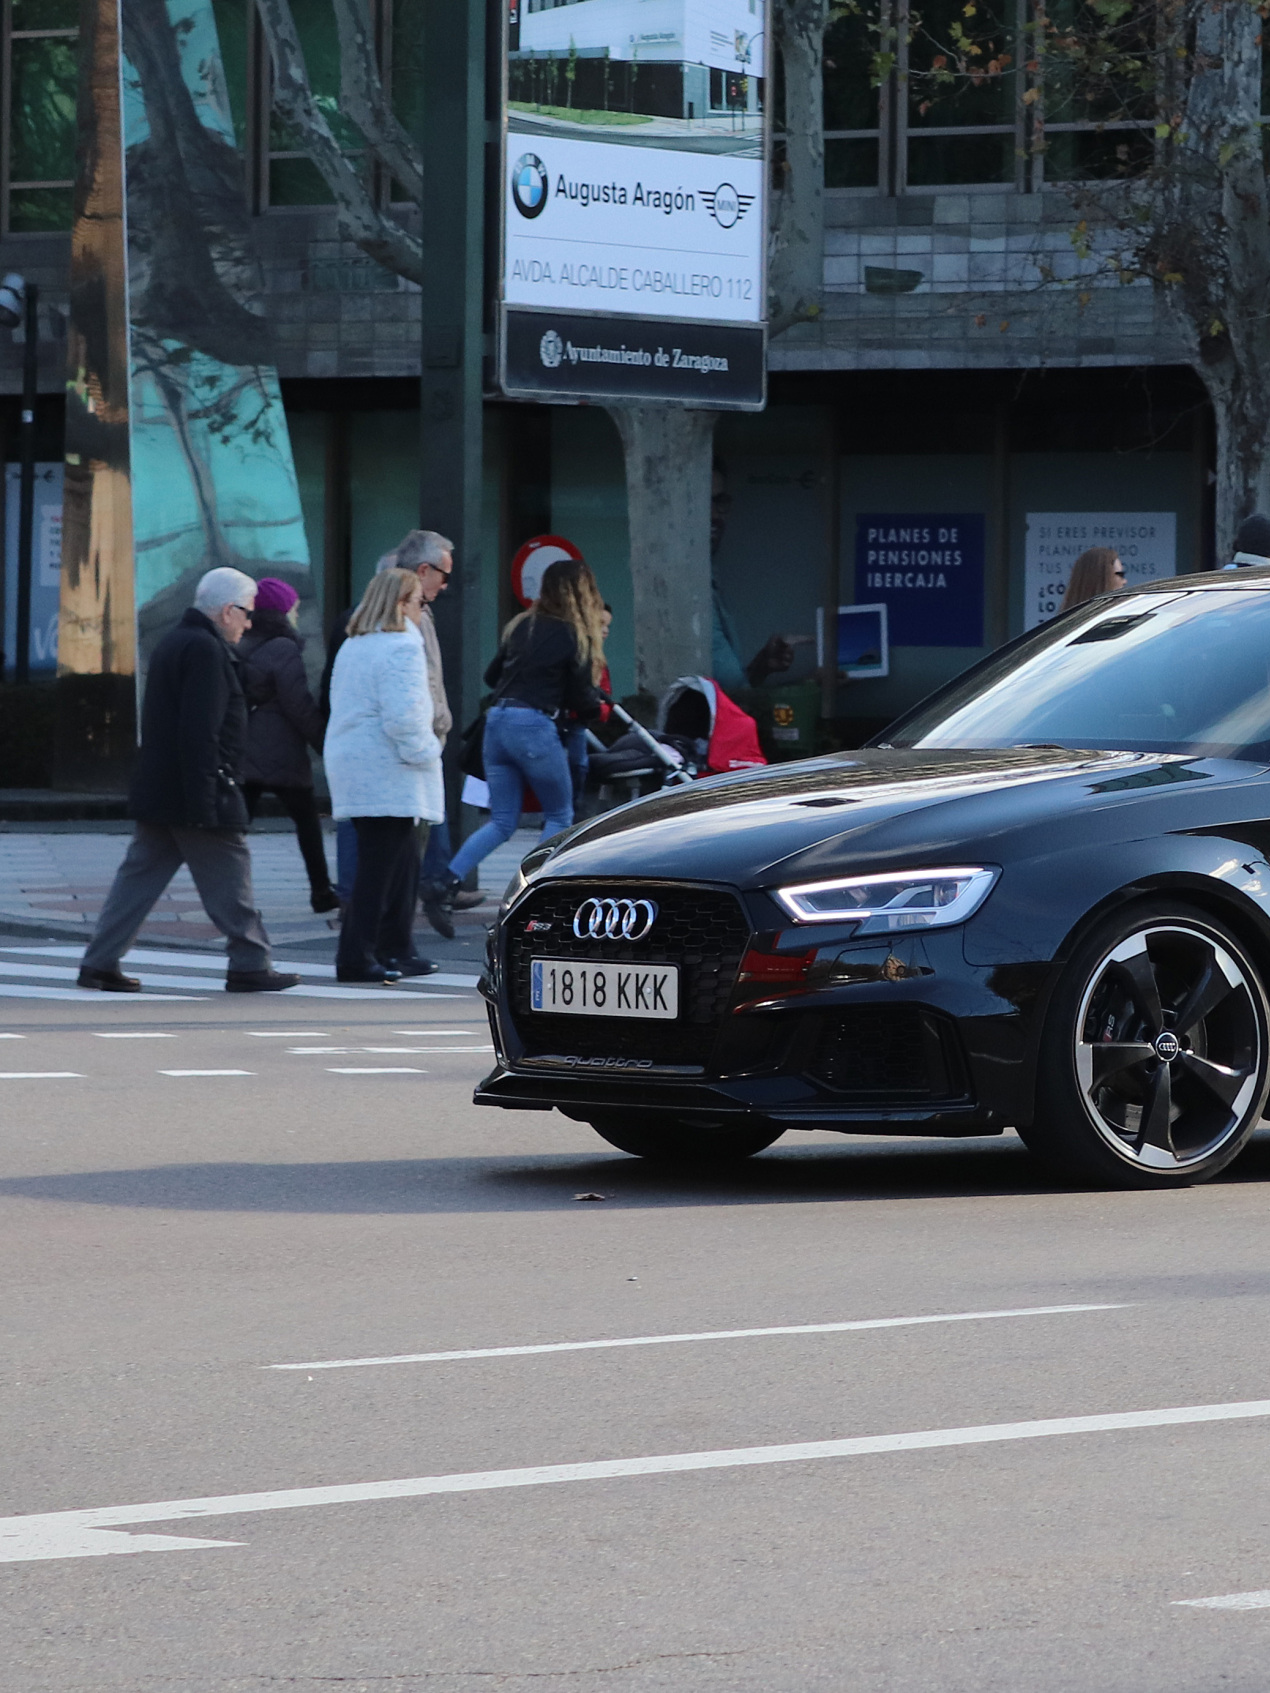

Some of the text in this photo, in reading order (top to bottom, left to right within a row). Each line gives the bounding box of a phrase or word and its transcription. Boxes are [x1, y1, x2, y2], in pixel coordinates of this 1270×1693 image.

[555, 174, 695, 215] Augusta Aragón
[716, 200, 737, 211] MINI
[512, 258, 752, 300] AVDA. ALCALDE CABALLERO 112
[563, 341, 729, 373] Ayuntamiento de Zaragoza
[867, 527, 958, 543] PLANES DE
[1039, 526, 1156, 539] SI ERES PREVISOR
[867, 550, 962, 565] PENSIONES
[1039, 562, 1062, 575] TUS
[867, 573, 947, 588] IBERCAJA
[1038, 601, 1056, 613] LO
[550, 968, 668, 1011] 1818 KKK
[564, 1055, 653, 1068] quattro
